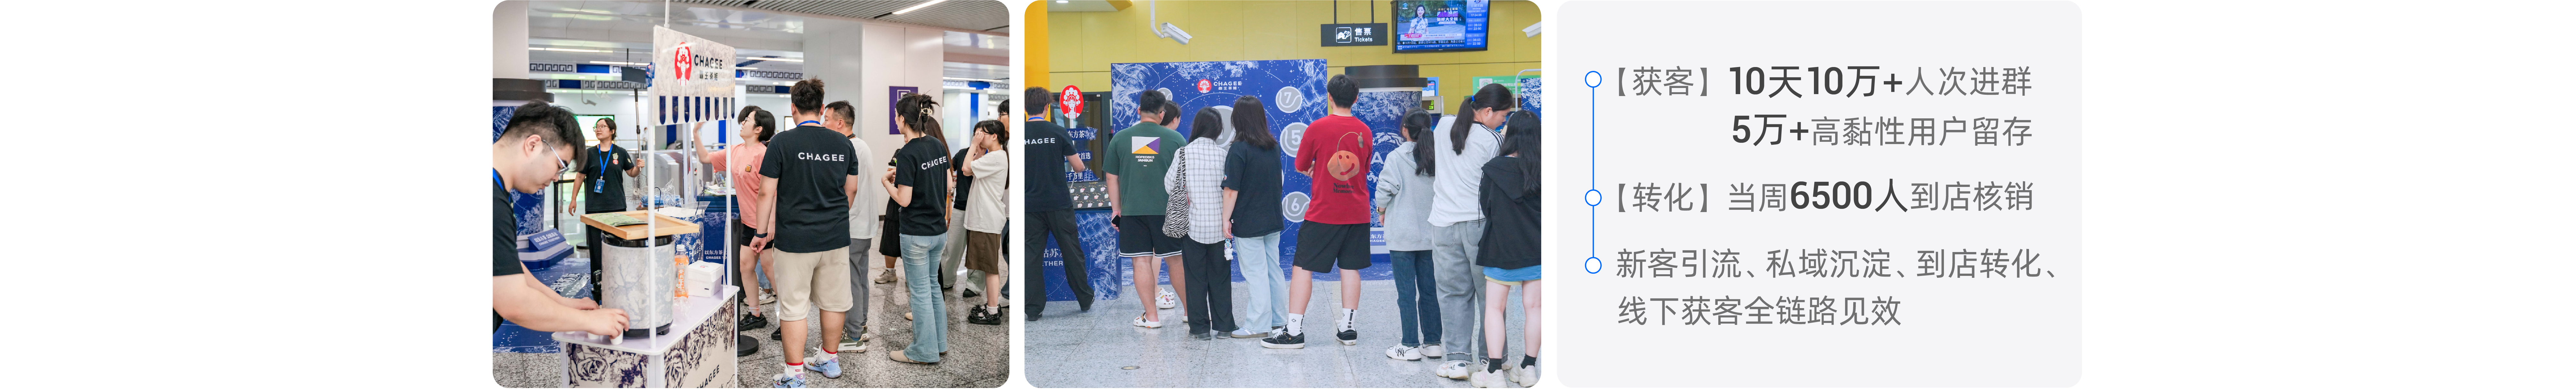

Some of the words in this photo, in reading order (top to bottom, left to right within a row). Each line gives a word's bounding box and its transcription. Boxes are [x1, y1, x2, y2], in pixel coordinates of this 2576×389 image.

[694, 54, 722, 69] CHAGEE
[1284, 92, 1292, 103] 7
[1292, 130, 1301, 145] 5
[798, 152, 844, 161] CHAGEE
[921, 156, 947, 170] CHAGEE
[1291, 198, 1300, 211] 6
[697, 365, 719, 388] HAGEE
